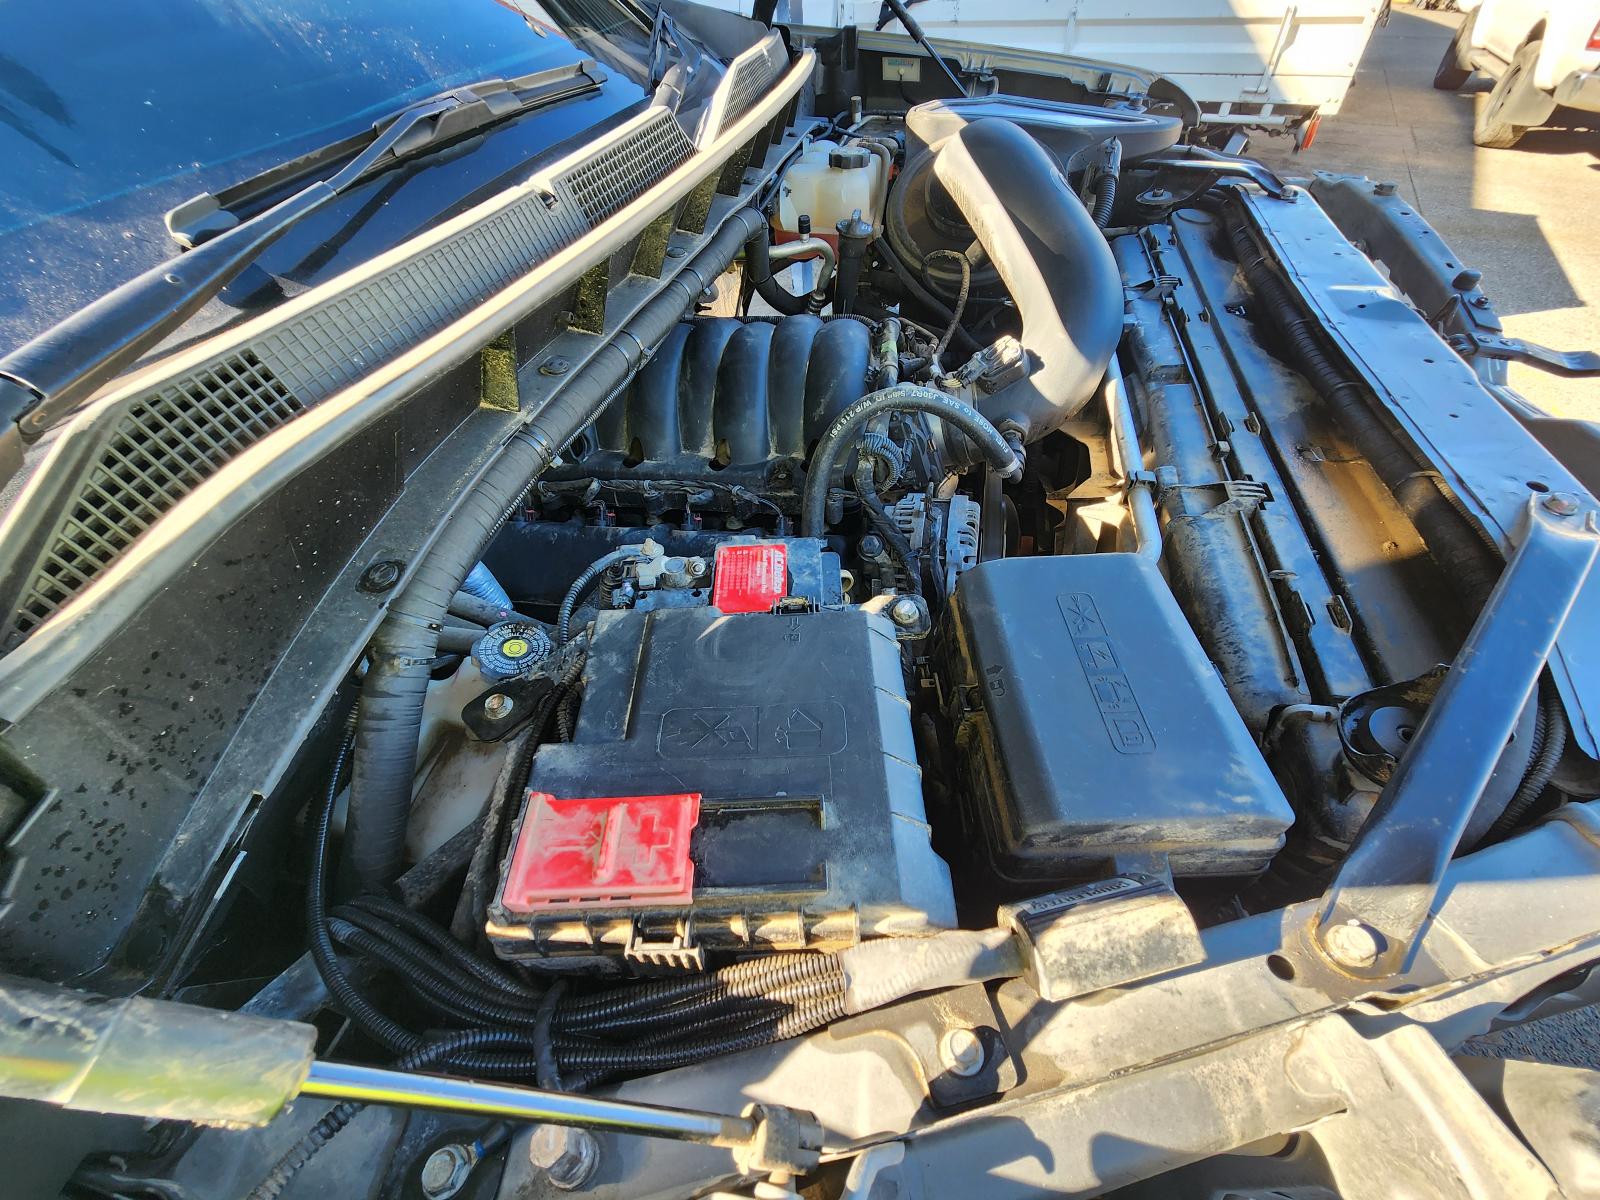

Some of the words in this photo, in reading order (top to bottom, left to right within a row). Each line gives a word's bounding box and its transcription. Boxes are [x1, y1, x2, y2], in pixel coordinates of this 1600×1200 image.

[911, 390, 938, 400] J30R7
[855, 399, 872, 412] W/P
[943, 398, 961, 409] SAE
[840, 410, 855, 425] 215
[974, 414, 993, 434] HOSE
[829, 423, 842, 438] PSI
[995, 433, 1008, 453] FUEL
